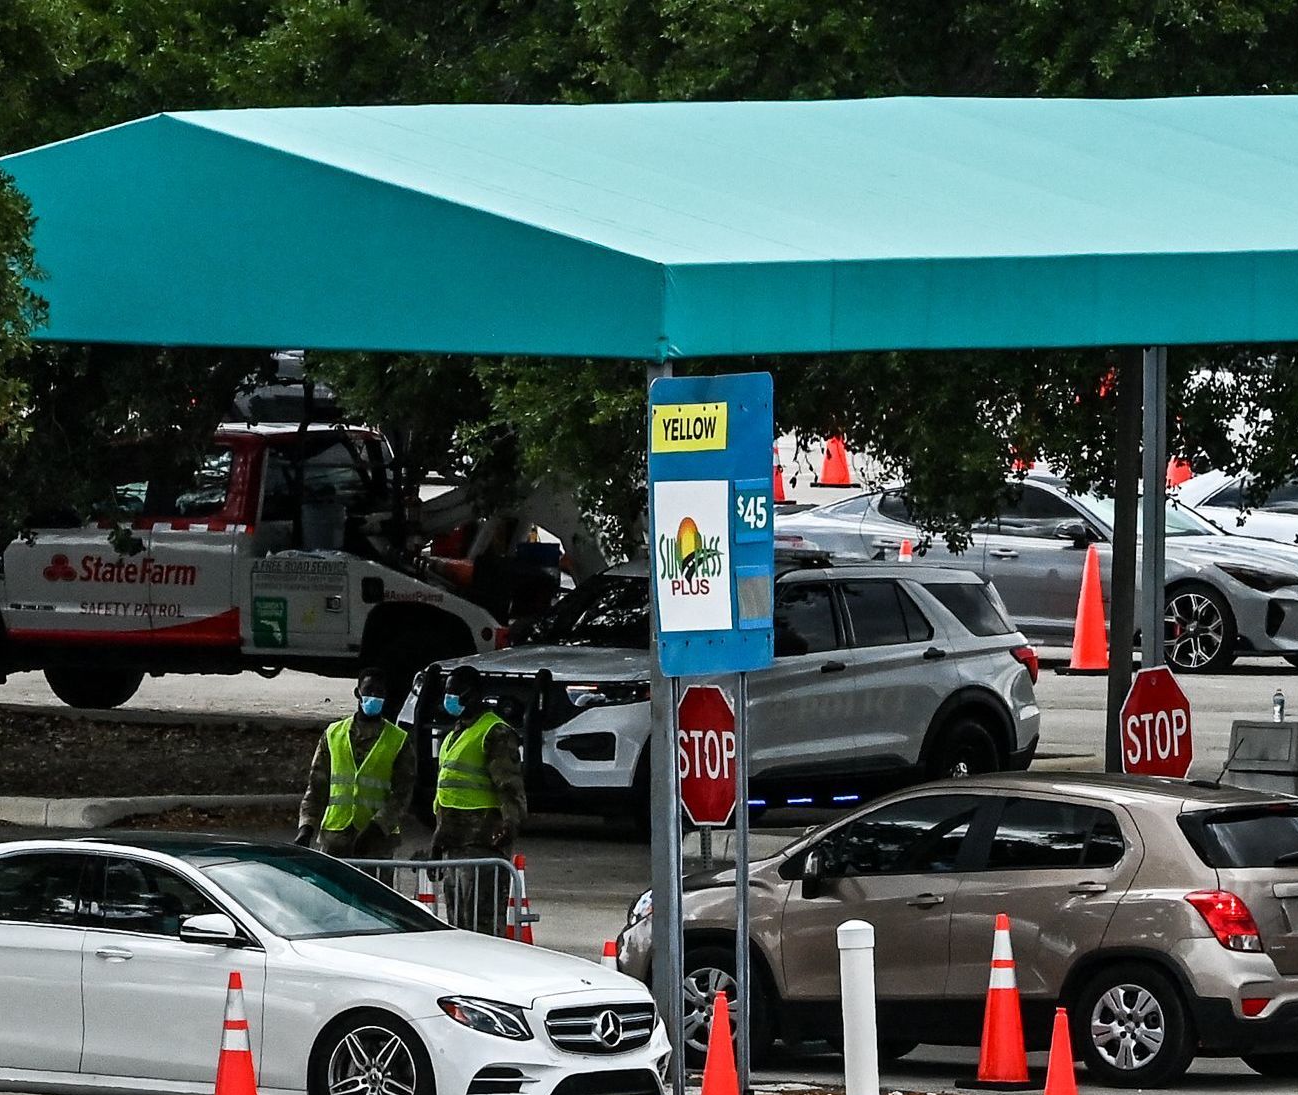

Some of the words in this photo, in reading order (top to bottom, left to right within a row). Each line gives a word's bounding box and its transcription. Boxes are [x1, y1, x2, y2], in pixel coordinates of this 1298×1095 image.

[662, 416, 716, 441] YELLOW
[737, 495, 767, 530] $45
[671, 579, 710, 596] PLUS
[80, 602, 130, 616] SAFETY
[134, 603, 185, 618] PATROL
[1127, 709, 1187, 764] STOP
[678, 729, 735, 779] STOP
